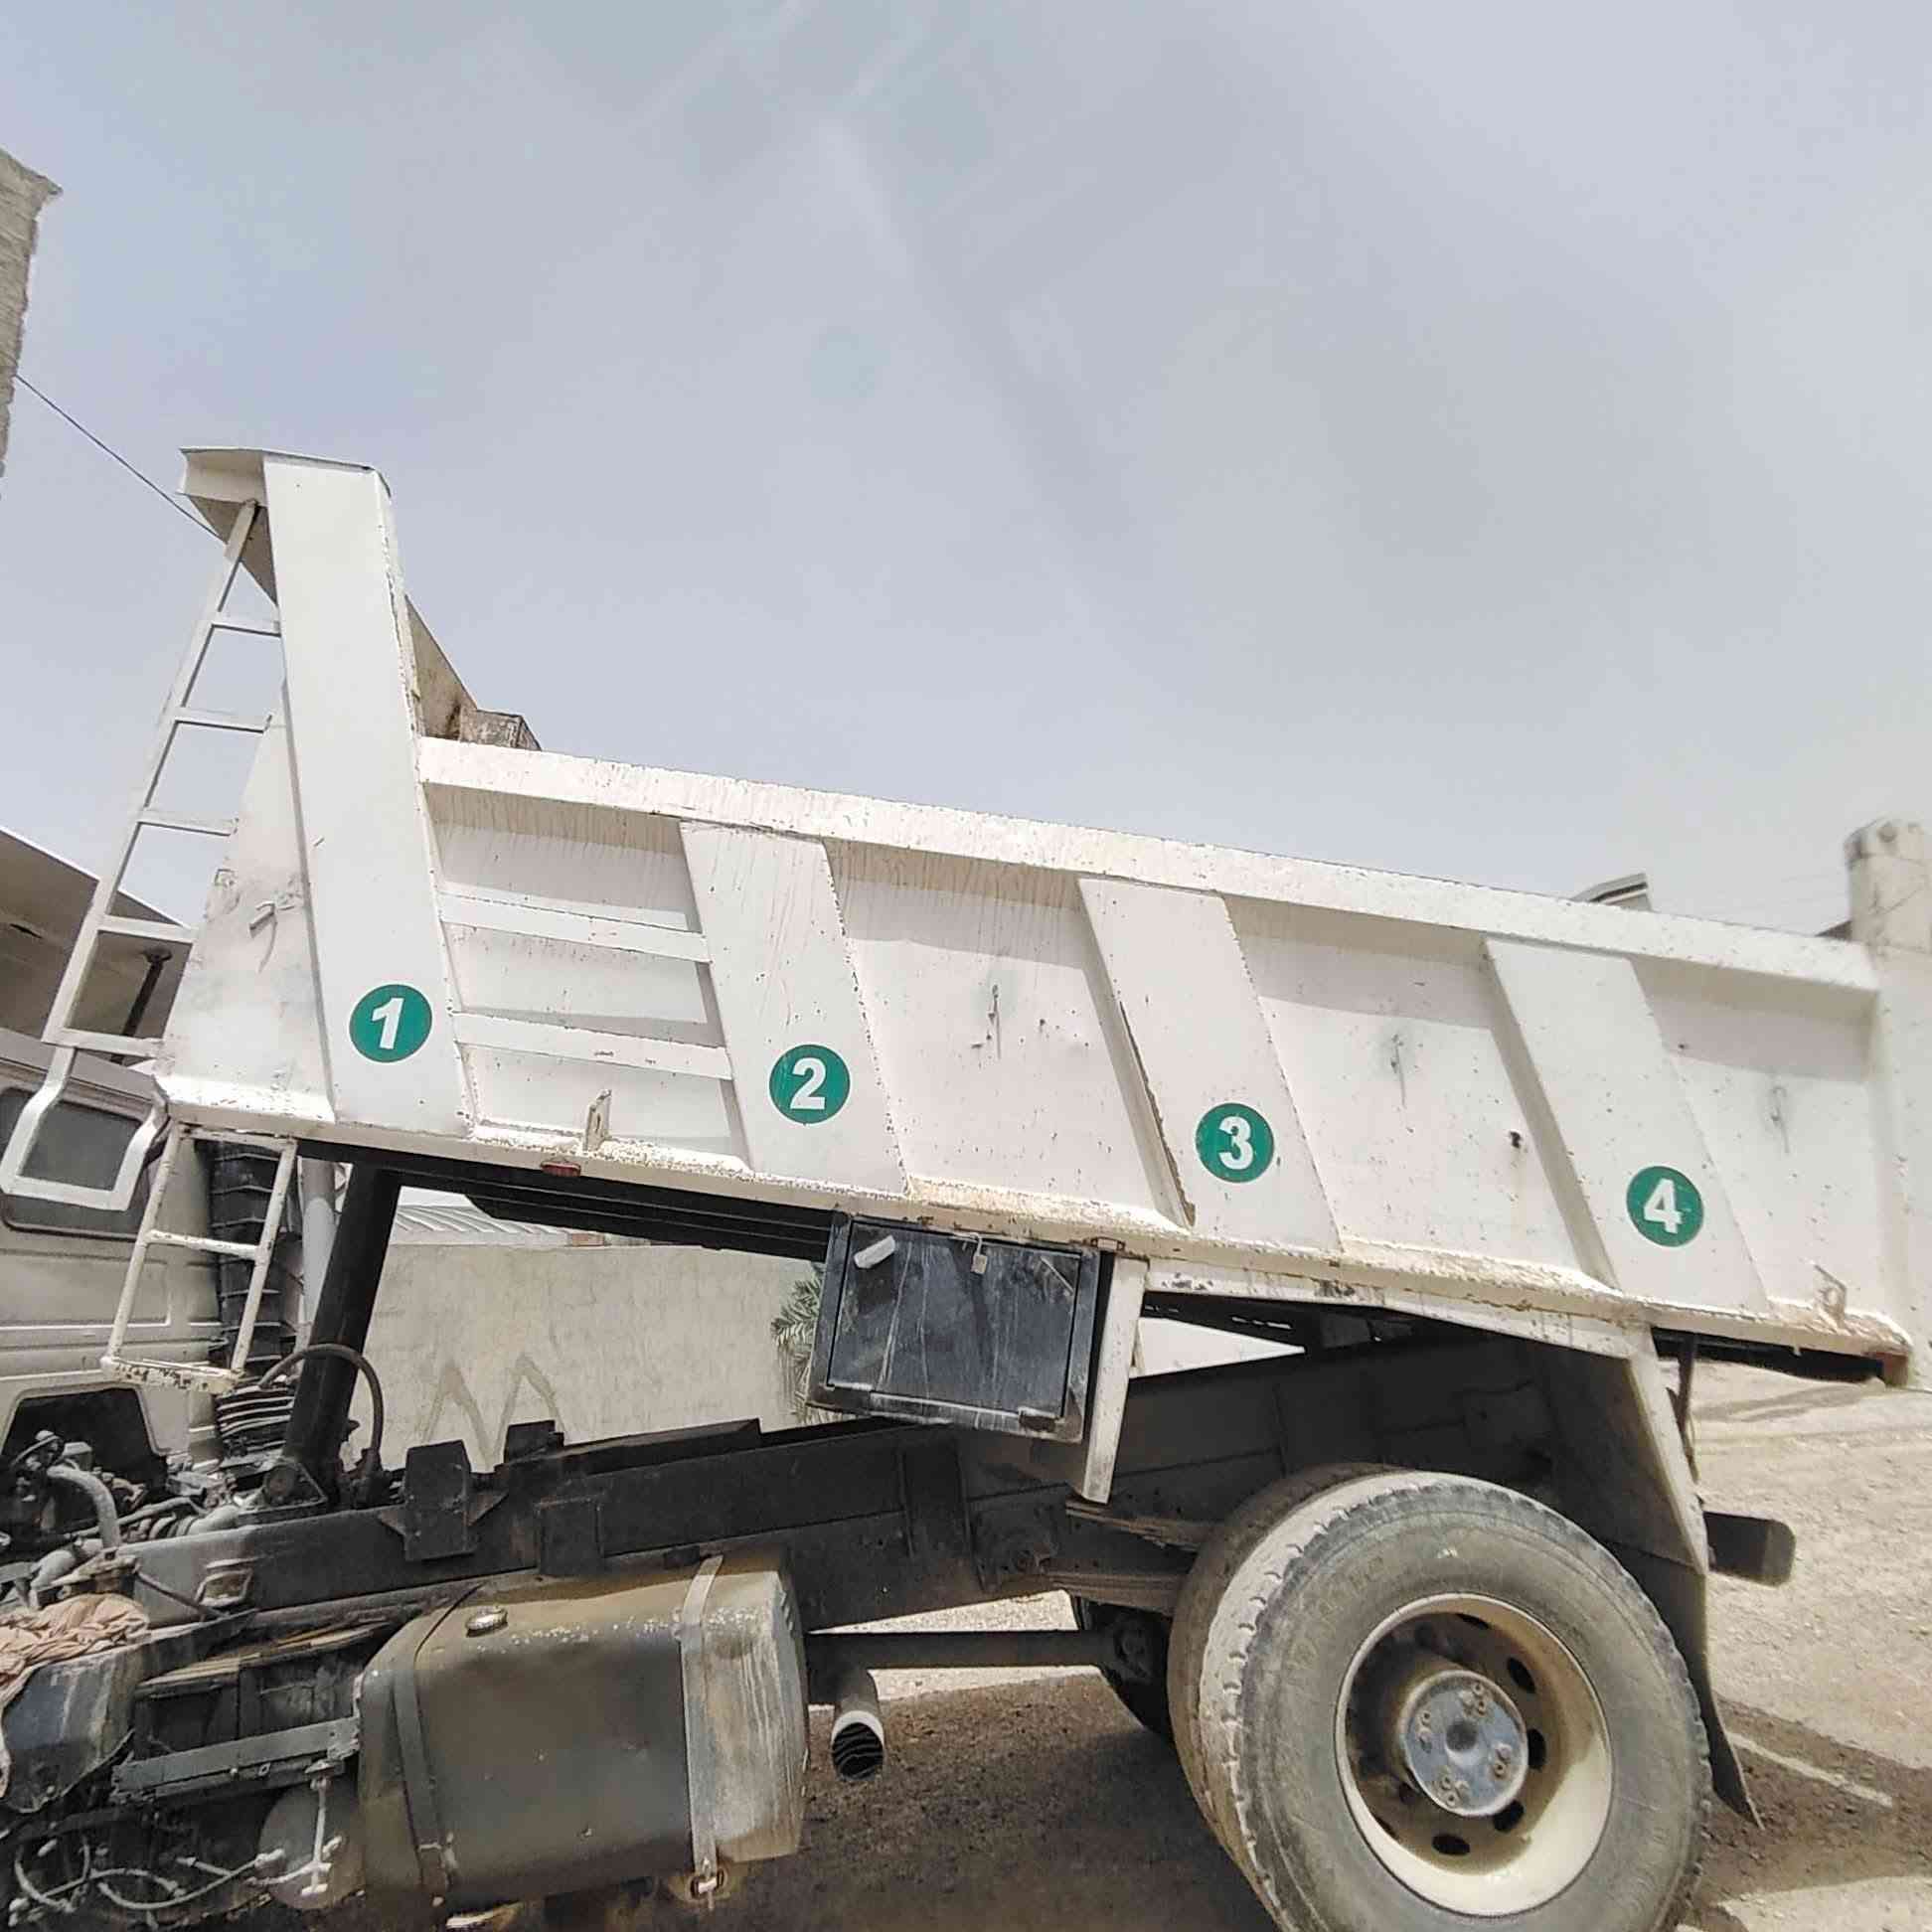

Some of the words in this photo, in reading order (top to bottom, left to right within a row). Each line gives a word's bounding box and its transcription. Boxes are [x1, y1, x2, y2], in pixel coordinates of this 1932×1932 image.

[371, 997, 405, 1049] 1
[789, 1057, 826, 1110] 2
[1219, 1116, 1253, 1170] 3
[1643, 1178, 1683, 1234] 4
